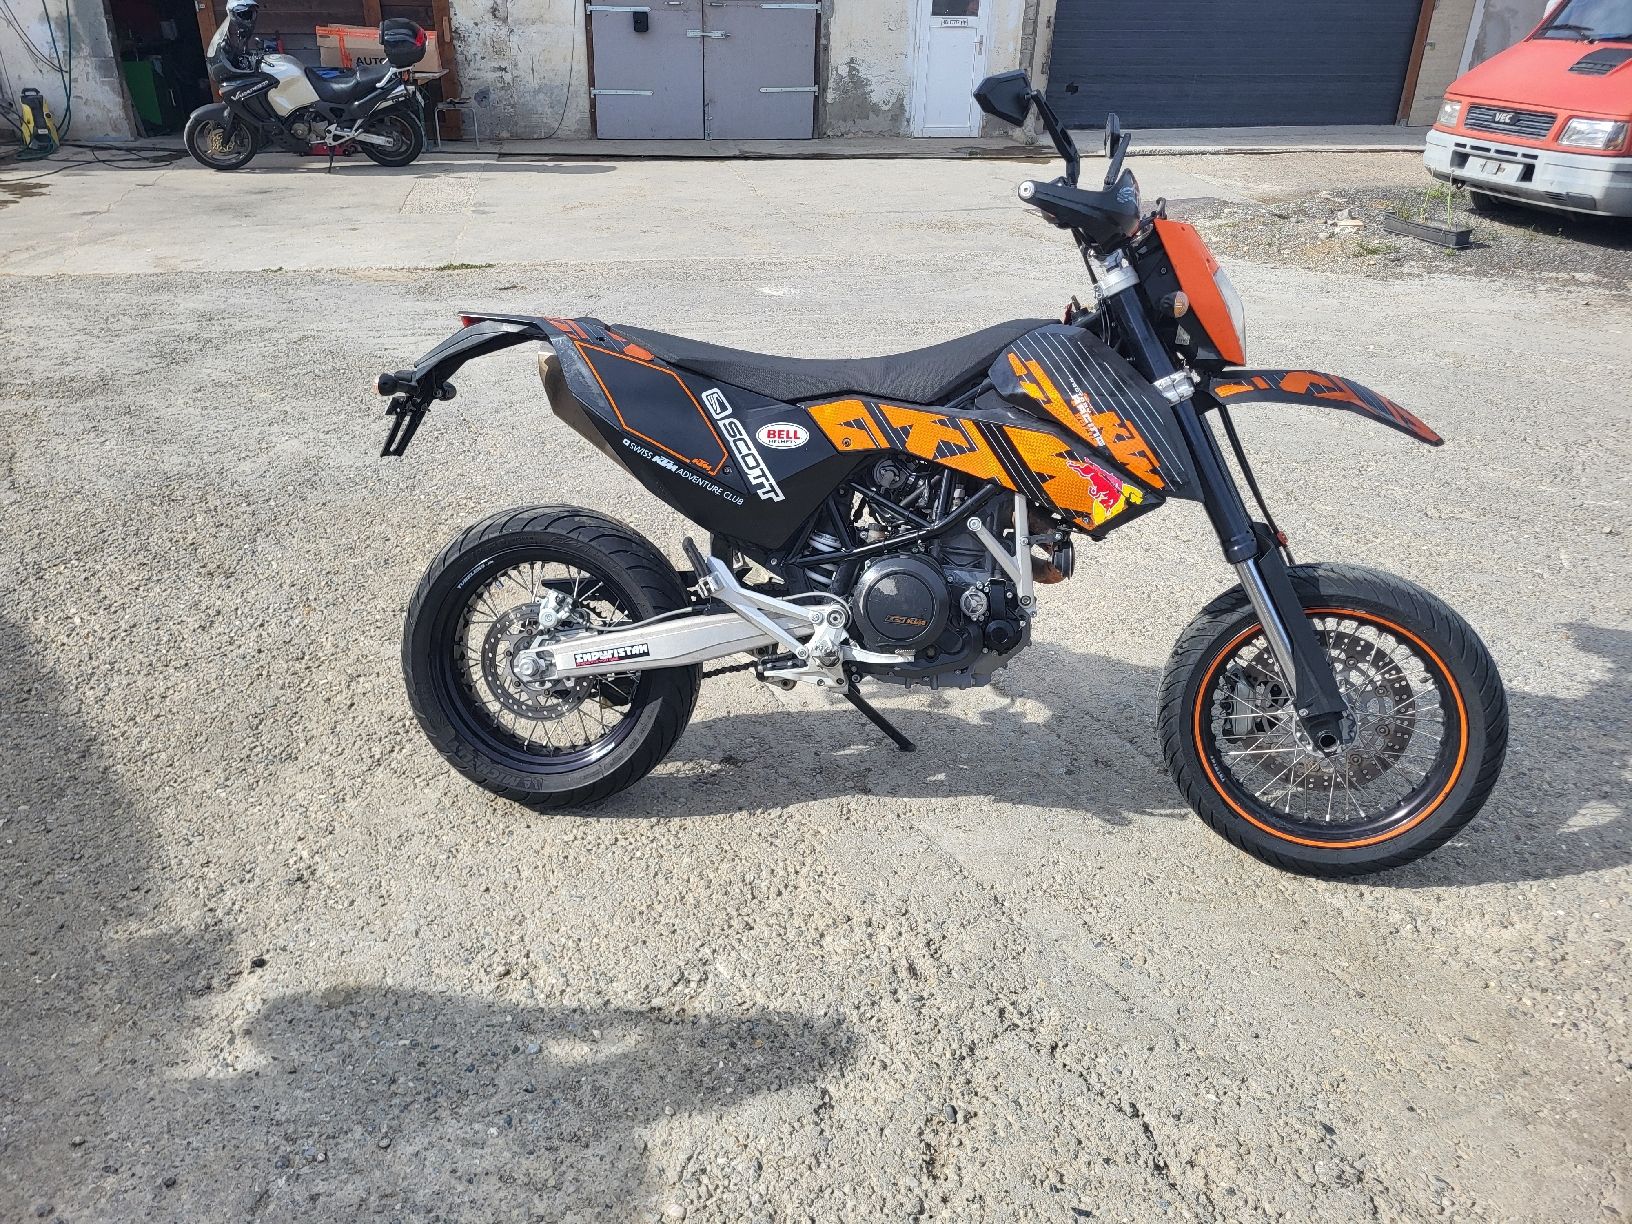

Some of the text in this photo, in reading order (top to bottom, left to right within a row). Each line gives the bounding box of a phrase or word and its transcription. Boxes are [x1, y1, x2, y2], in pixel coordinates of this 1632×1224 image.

[717, 418, 785, 502] SCOTT
[766, 429, 801, 440] BELL
[629, 442, 744, 506] SWISS KTM ADVENTURE CLUB
